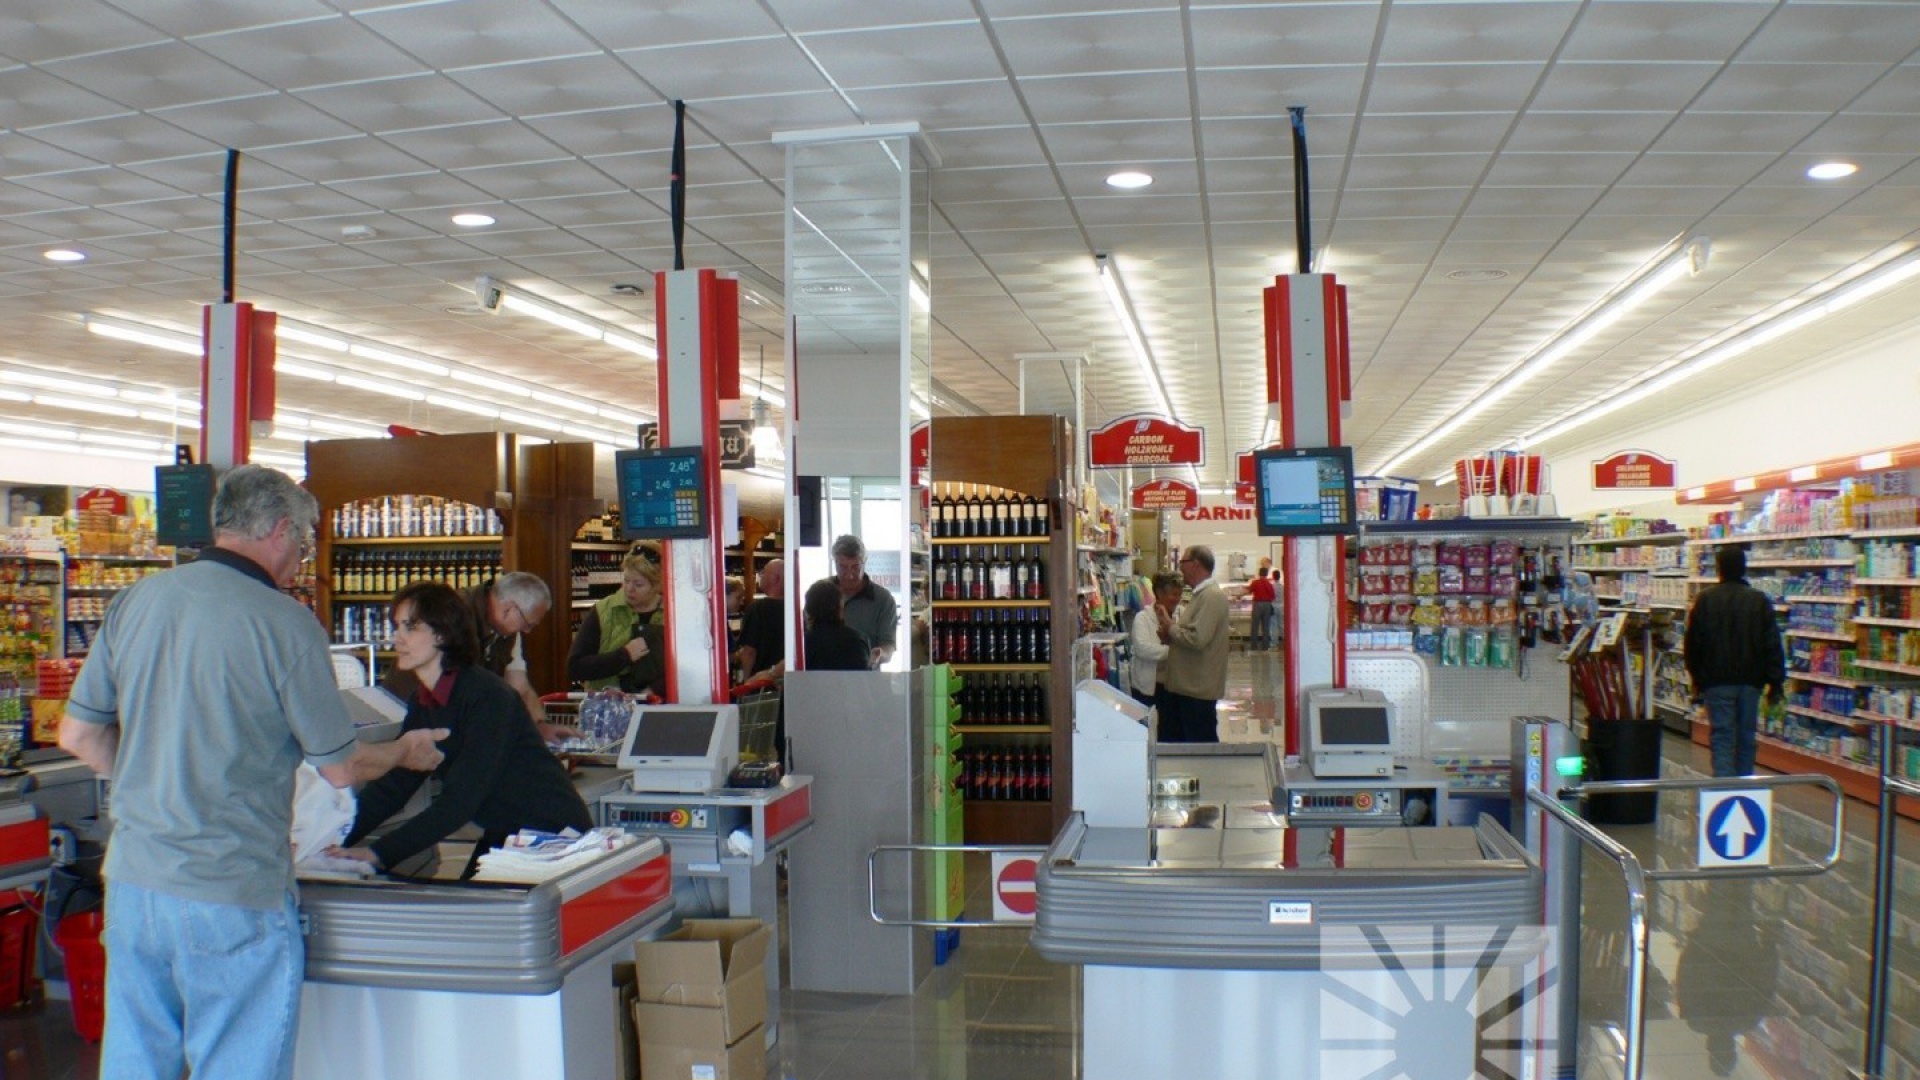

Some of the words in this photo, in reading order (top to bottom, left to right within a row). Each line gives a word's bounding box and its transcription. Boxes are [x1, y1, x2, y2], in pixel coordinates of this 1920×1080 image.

[1129, 435, 1164, 444] CARBON
[1125, 445, 1173, 454] HOLZKOHLE
[1126, 455, 1170, 464] CHARCOAL
[1181, 507, 1258, 521] CARNI
